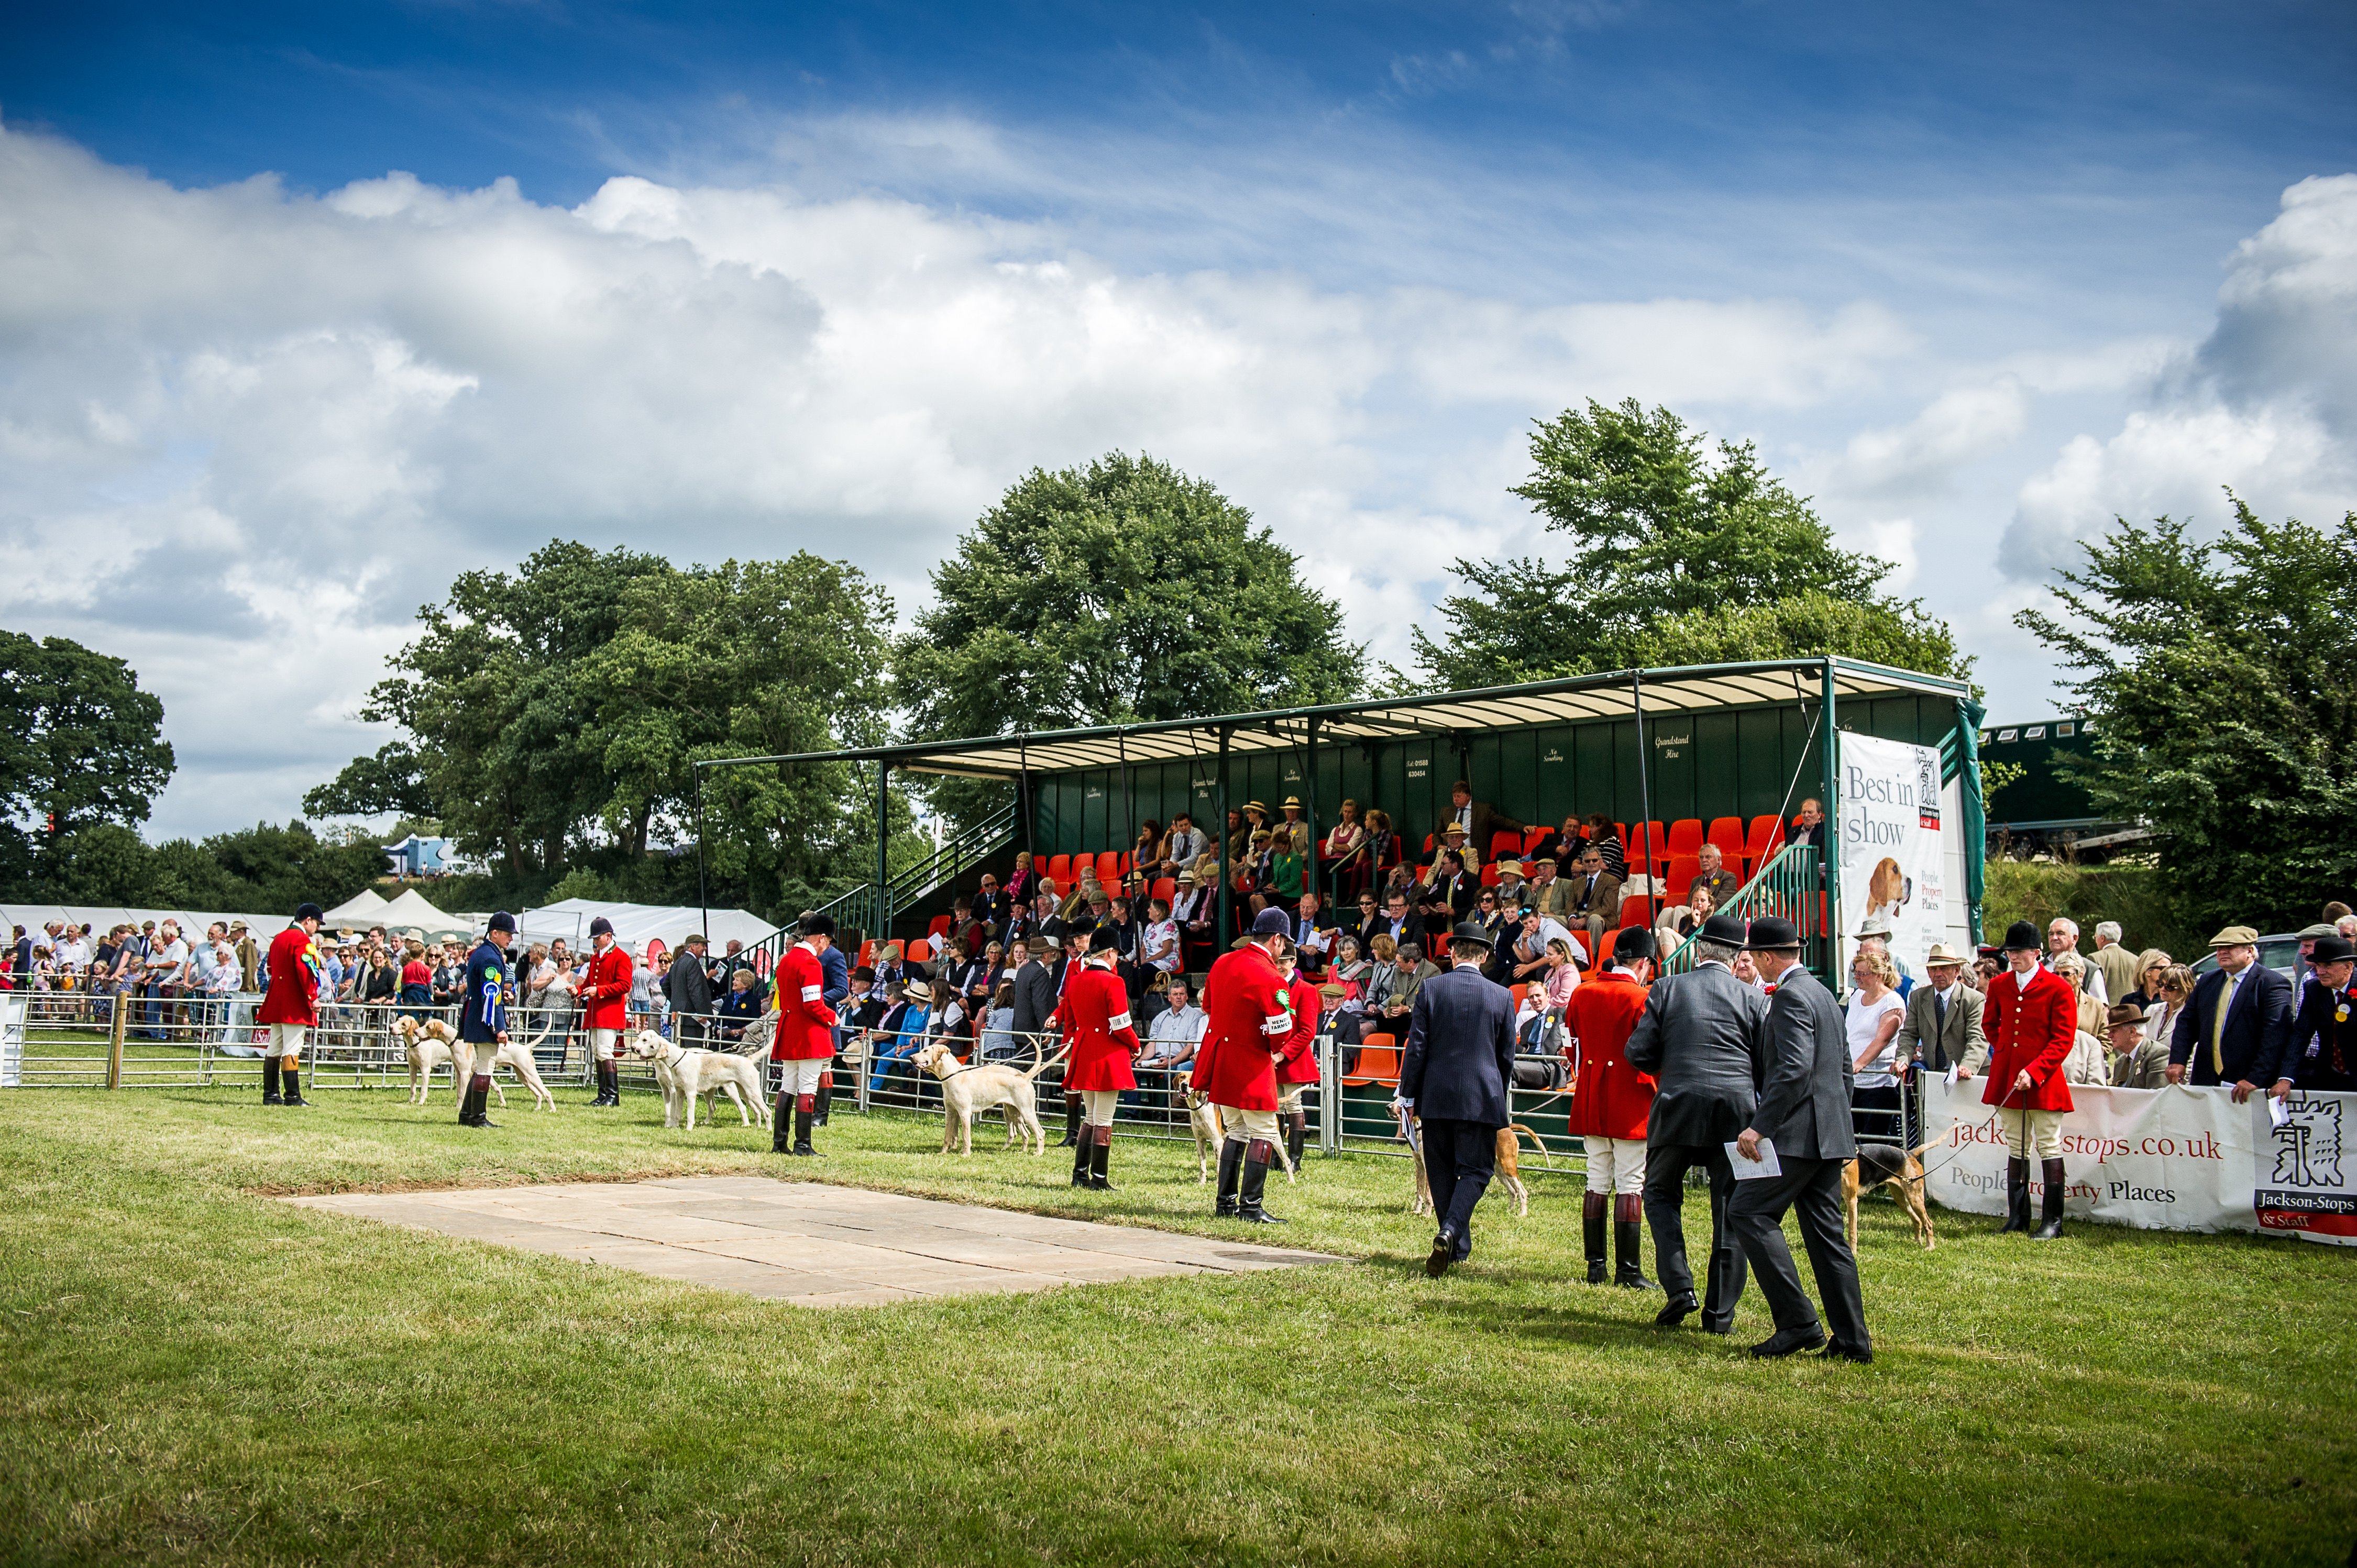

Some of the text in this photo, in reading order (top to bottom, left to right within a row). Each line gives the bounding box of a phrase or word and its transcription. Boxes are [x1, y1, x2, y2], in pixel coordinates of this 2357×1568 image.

[1655, 734, 1689, 748] Grandstand
[1665, 749, 1679, 759] Hire
[1192, 777, 1216, 789] Grandtand
[1847, 766, 1915, 807] Best in
[1847, 806, 1905, 846] show
[1922, 870, 1938, 886] People
[1922, 884, 1943, 901] Property
[1922, 898, 1939, 910] Places
[1272, 1016, 1289, 1025] MEND
[1949, 1117, 2223, 1164] jackstops.co.uk
[1951, 1166, 2008, 1195] People
[2029, 1181, 2102, 1205] roerty
[2109, 1181, 2176, 1203] Places
[2259, 1192, 2355, 1213] Jackson-Stops
[2262, 1212, 2310, 1227] & Staff
